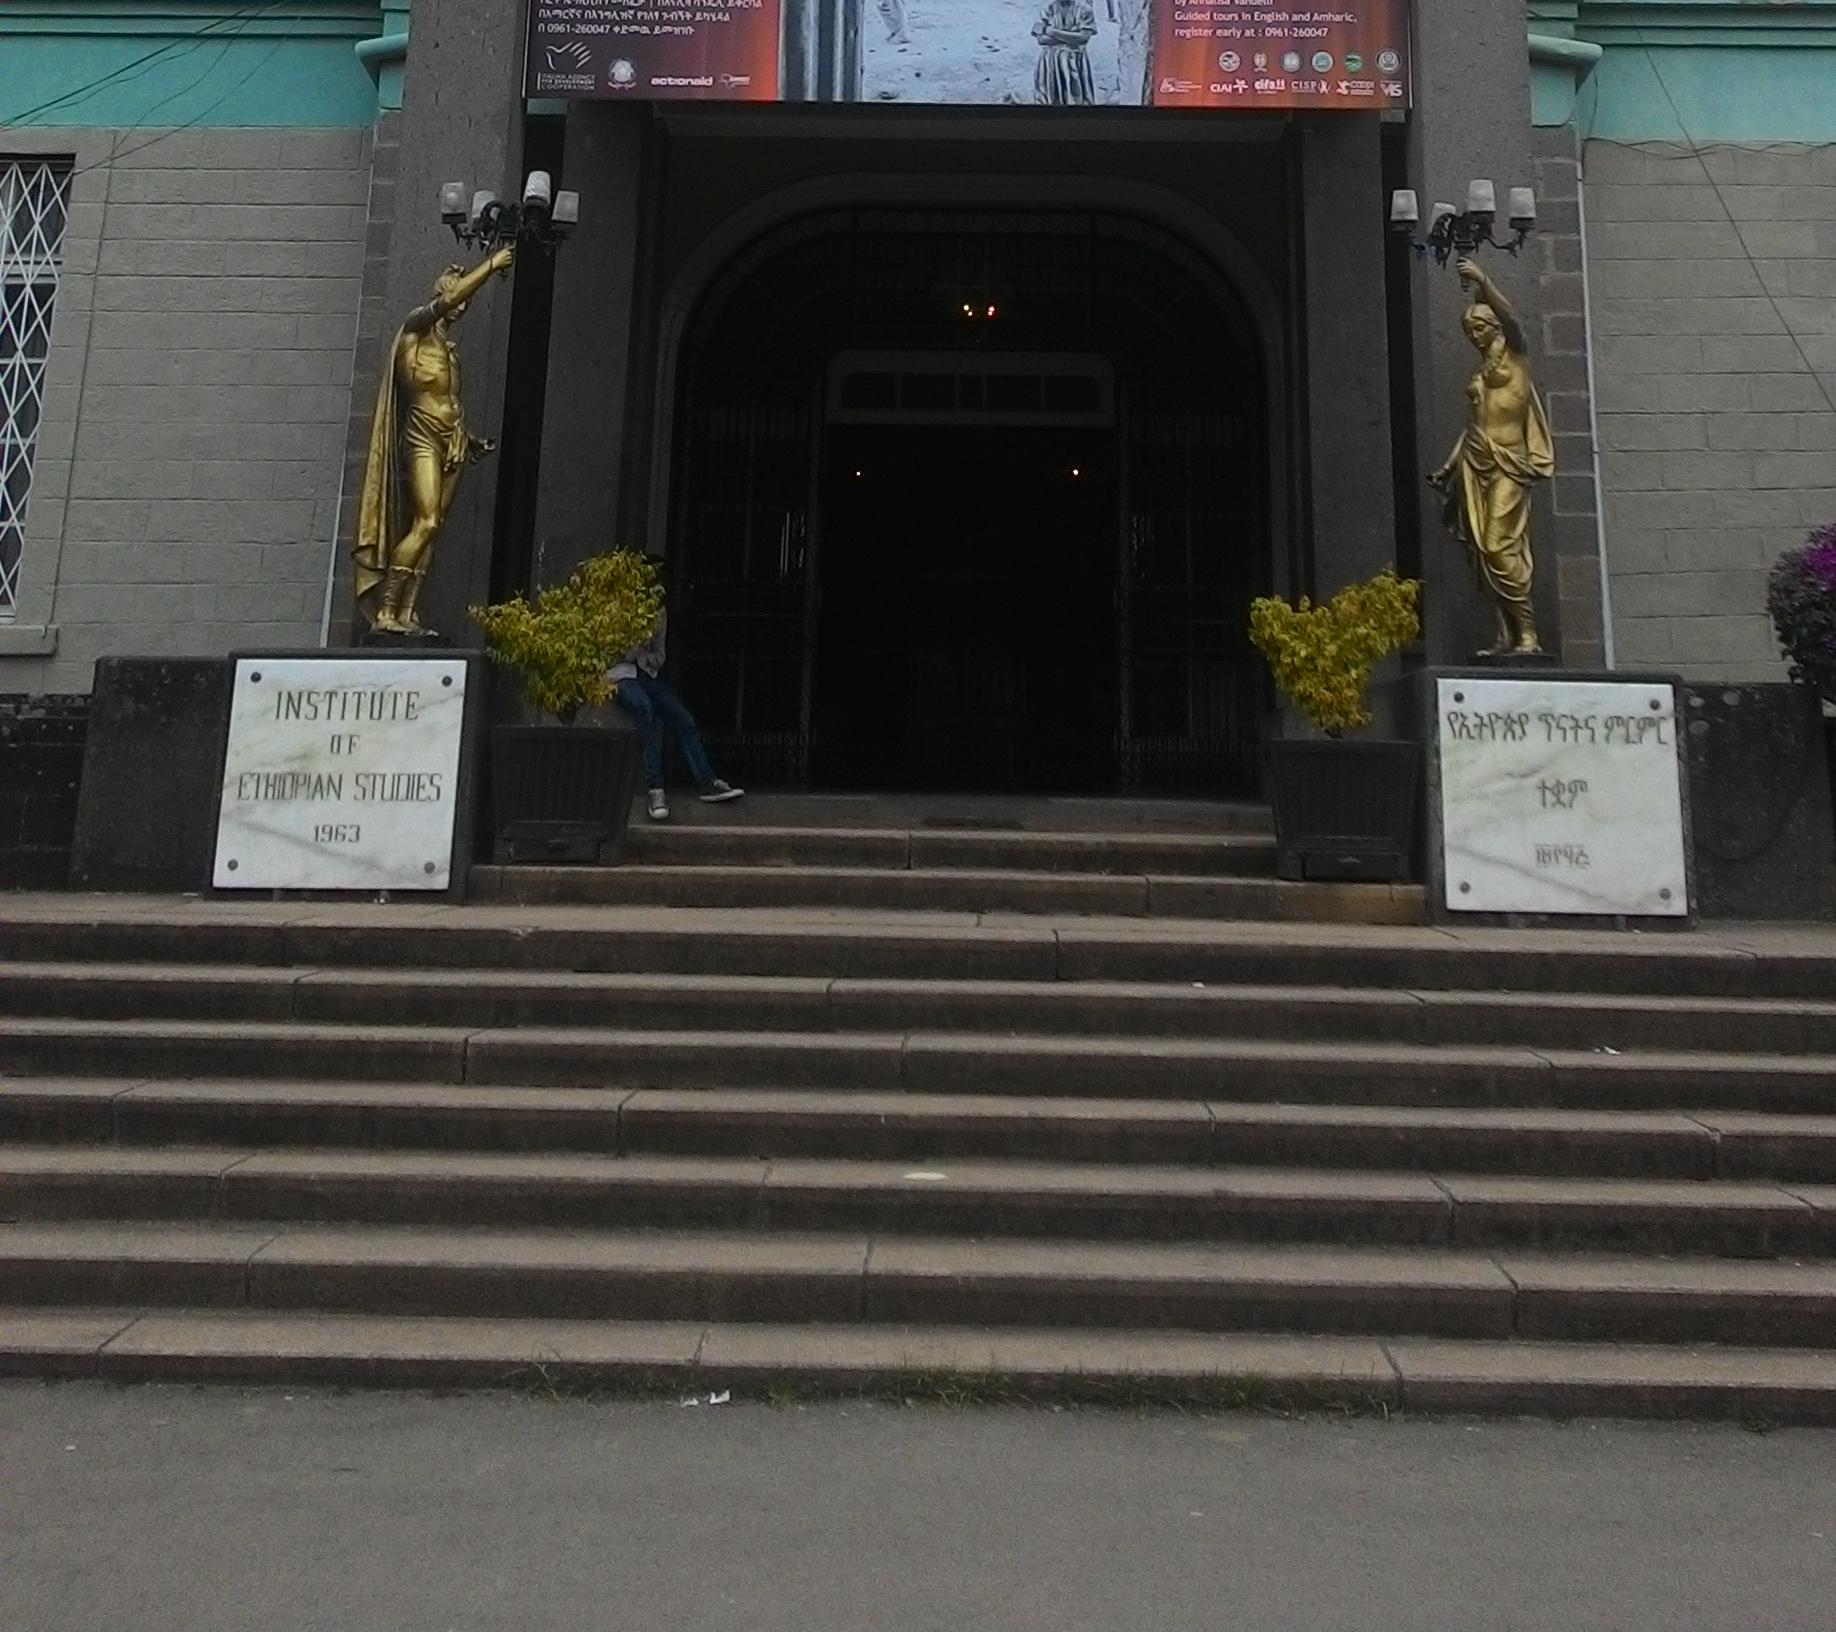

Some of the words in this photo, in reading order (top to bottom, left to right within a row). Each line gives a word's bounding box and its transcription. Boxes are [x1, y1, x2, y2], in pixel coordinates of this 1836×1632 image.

[1174, 11, 1211, 21] Guided
[1213, 11, 1239, 21] tours
[1241, 11, 1252, 21] in
[1253, 11, 1289, 23] English
[1291, 12, 1311, 22] and
[547, 23, 611, 34] 0961-260047
[1174, 28, 1213, 39] register
[1215, 28, 1242, 39] early
[1244, 28, 1255, 38] at
[1264, 27, 1329, 38] 0961-260047
[650, 76, 714, 86] actionaid
[1291, 80, 1318, 90] CISP
[275, 691, 420, 721] INSTITUTE
[1448, 712, 1529, 742] የኢትዮጵያ
[1538, 714, 1597, 744] ጥናትና
[1604, 715, 1668, 745] ምርምር
[330, 734, 361, 755] OF
[237, 772, 343, 802] ETHIOPIAN
[353, 773, 442, 802] STUDIES
[1537, 779, 1588, 808] ተቋም
[313, 824, 361, 843] 1963
